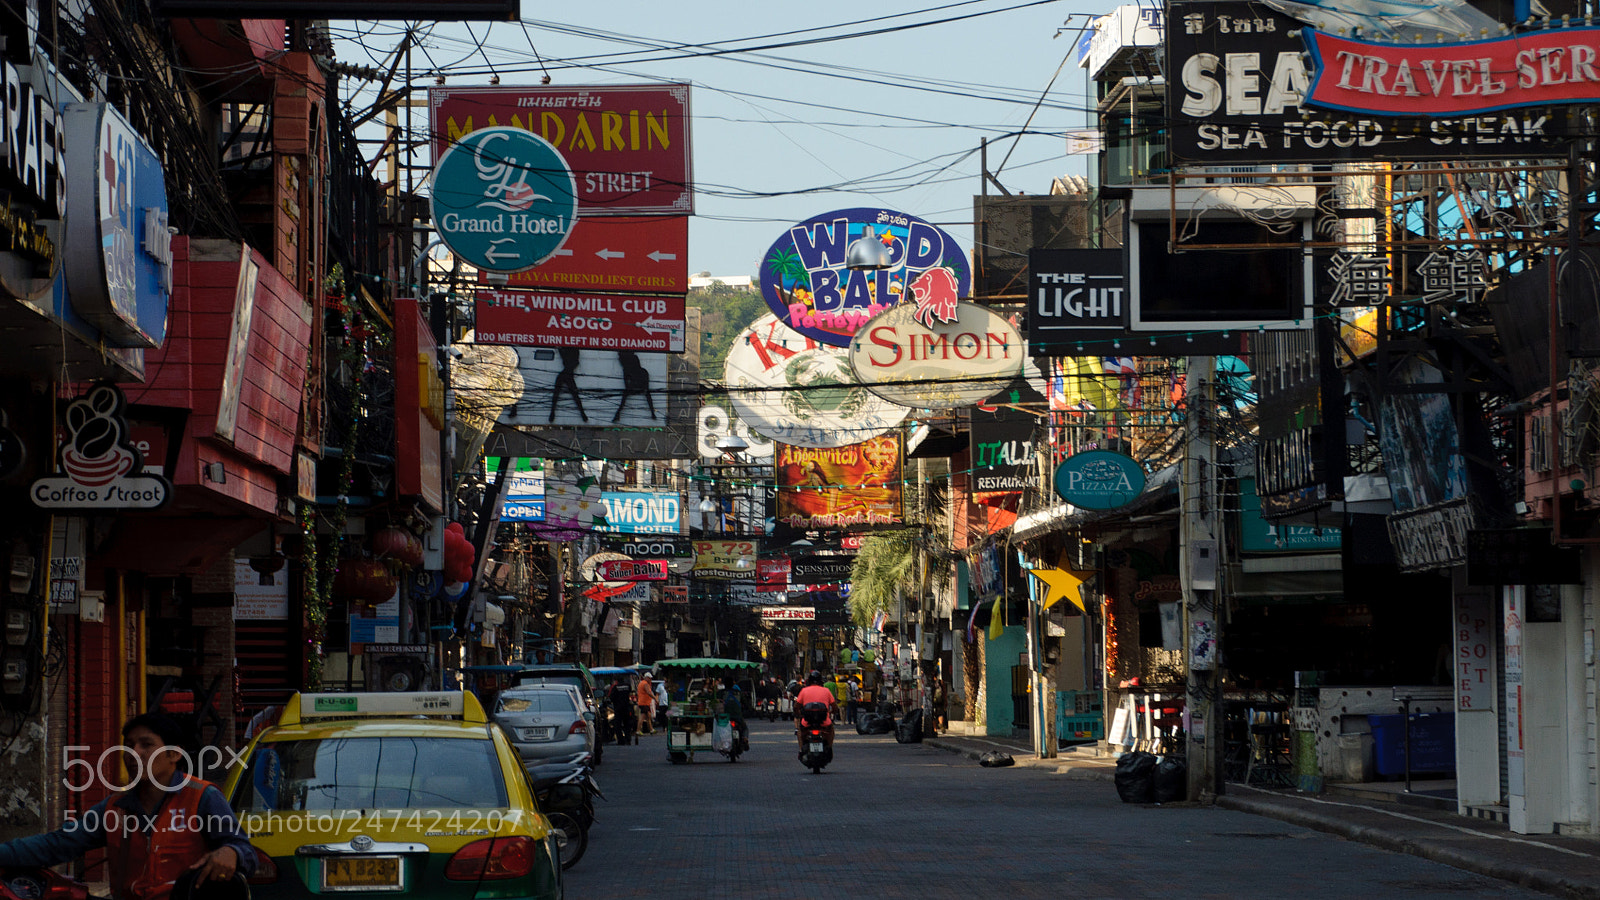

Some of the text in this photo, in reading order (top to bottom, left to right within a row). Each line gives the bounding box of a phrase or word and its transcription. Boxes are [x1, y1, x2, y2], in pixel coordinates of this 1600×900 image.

[1336, 51, 1505, 97] TRAVEL
[1197, 123, 1269, 150] SEA
[1283, 120, 1383, 149] FOOD
[1430, 115, 1550, 144] STEAK
[585, 171, 653, 193] STREET
[442, 213, 566, 236] Grand Hotel
[553, 272, 639, 287] FRIENDLIEST
[641, 276, 676, 288] GIRLS
[1037, 273, 1086, 284] THE
[493, 293, 667, 314] THE WINDMILL CLUB
[1038, 287, 1124, 318] LIGHT
[547, 315, 613, 331] AGOGO
[478, 332, 496, 342] 100
[497, 333, 535, 344] METRES
[537, 334, 562, 345] TURN
[564, 336, 587, 346] LEFT
[590, 336, 599, 347] IN
[601, 337, 618, 347] SOI
[620, 338, 666, 349] DIAMOND
[868, 326, 1010, 368] SIMON
[35, 485, 161, 501] Coffee Street
[508, 506, 541, 517] OPEN
[634, 525, 679, 534] HOTEL
[624, 543, 675, 555] moon
[633, 562, 662, 576] Baby
[694, 569, 756, 579] Restaurant
[1459, 597, 1472, 708] LOBSTER
[1473, 619, 1488, 684] POT
